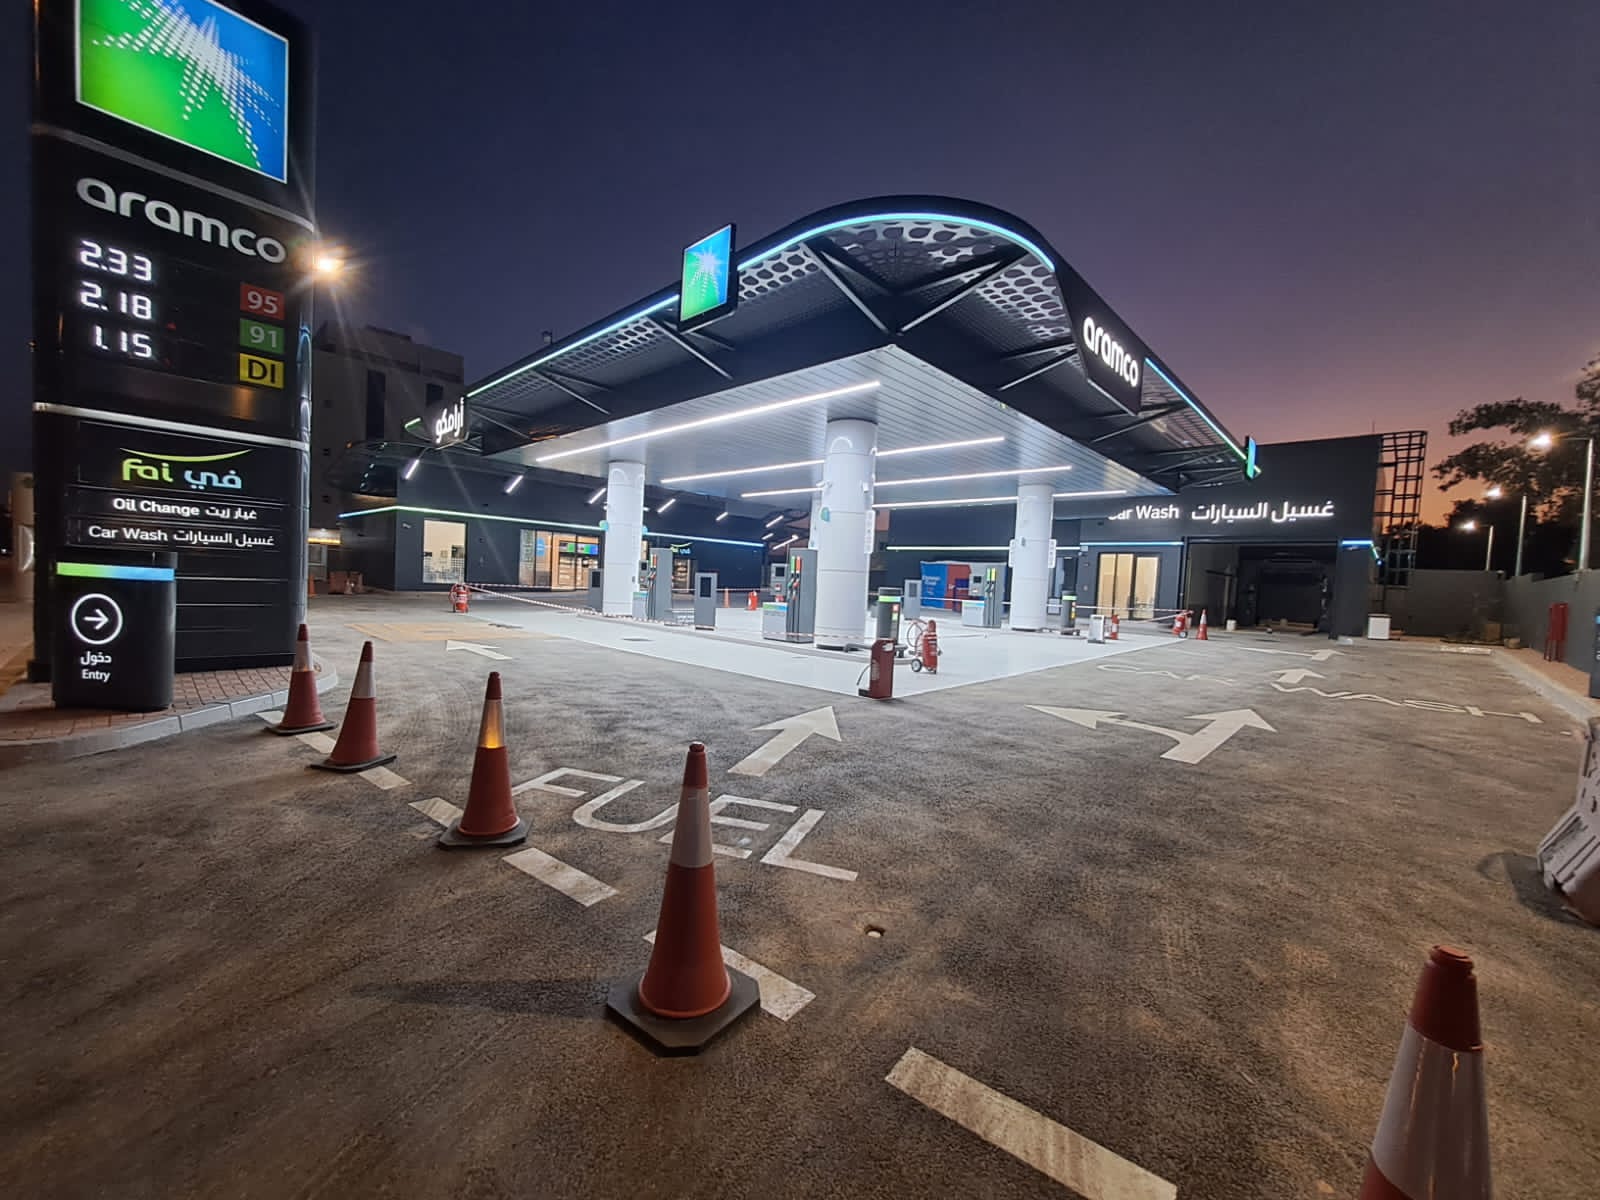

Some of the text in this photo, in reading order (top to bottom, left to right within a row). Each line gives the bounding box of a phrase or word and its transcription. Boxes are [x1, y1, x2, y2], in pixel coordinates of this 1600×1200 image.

[76, 177, 286, 264] aramco
[80, 239, 152, 281] 2.33
[80, 280, 152, 320] 2.18
[247, 290, 279, 314] 95
[95, 325, 152, 358] 1.15
[249, 325, 278, 349] 91
[1083, 316, 1138, 387] aramco
[435, 396, 464, 444] أرامكو
[184, 469, 242, 490] في
[113, 498, 200, 518] Oil Change
[1108, 504, 1180, 521] ar Wash
[1191, 500, 1335, 524] غسيل السيارات
[88, 525, 168, 542] Car Wash
[173, 530, 275, 548] غسيل السيارات
[80, 650, 112, 666] دخول
[81, 668, 111, 683] Entry
[510, 767, 858, 881] FUEL
